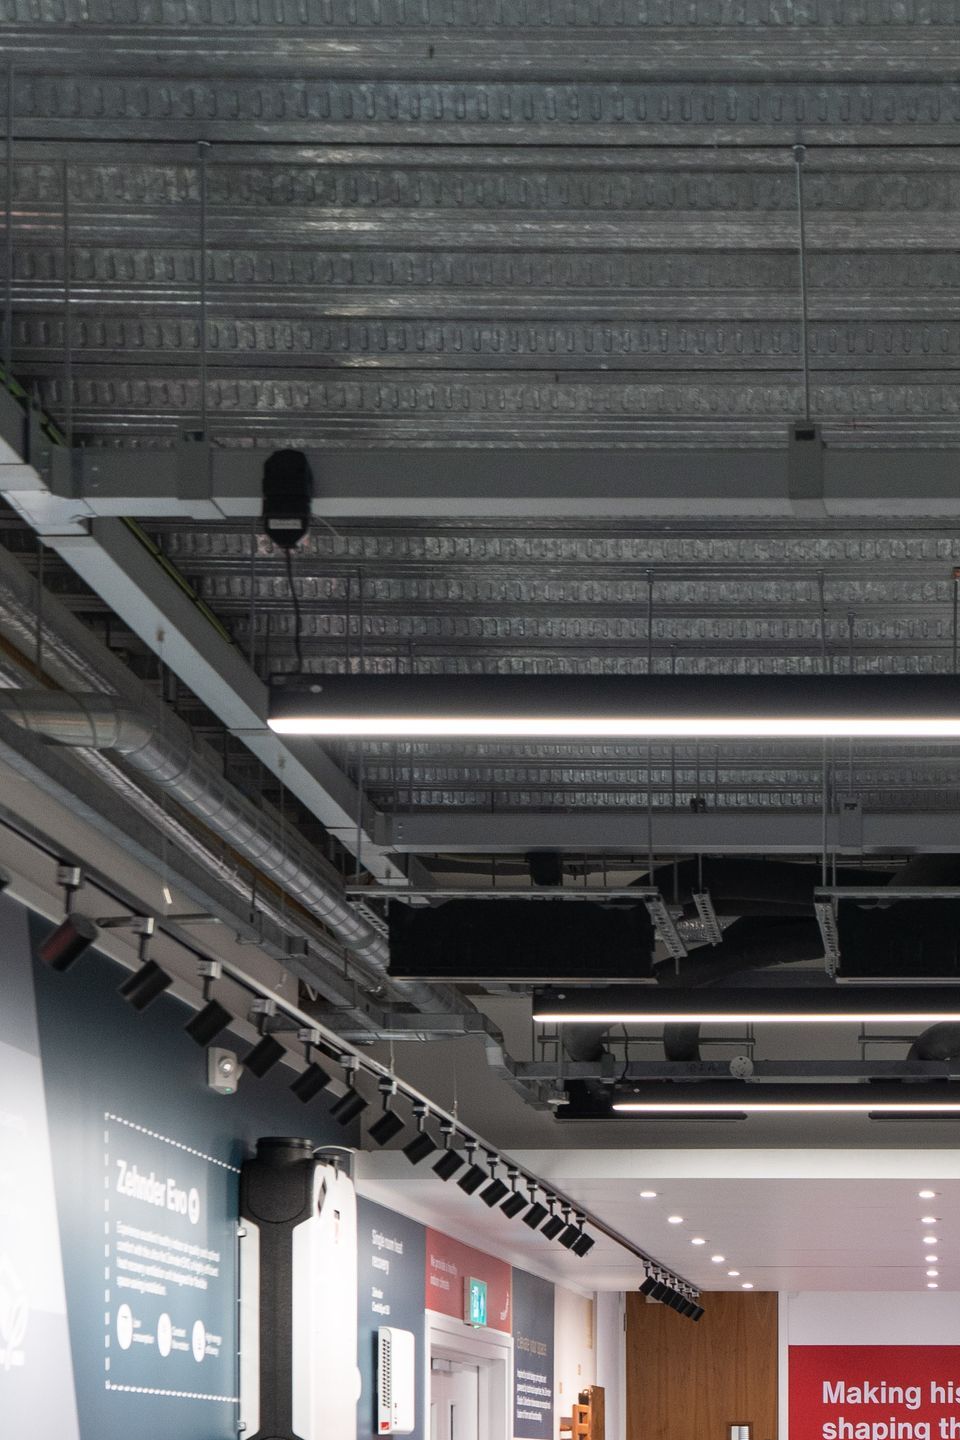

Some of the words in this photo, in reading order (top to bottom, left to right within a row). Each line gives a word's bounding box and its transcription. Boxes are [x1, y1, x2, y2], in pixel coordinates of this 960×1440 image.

[116, 1159, 166, 1207] Zehnder
[167, 1178, 187, 1215] Evo
[821, 1380, 922, 1410] Making
